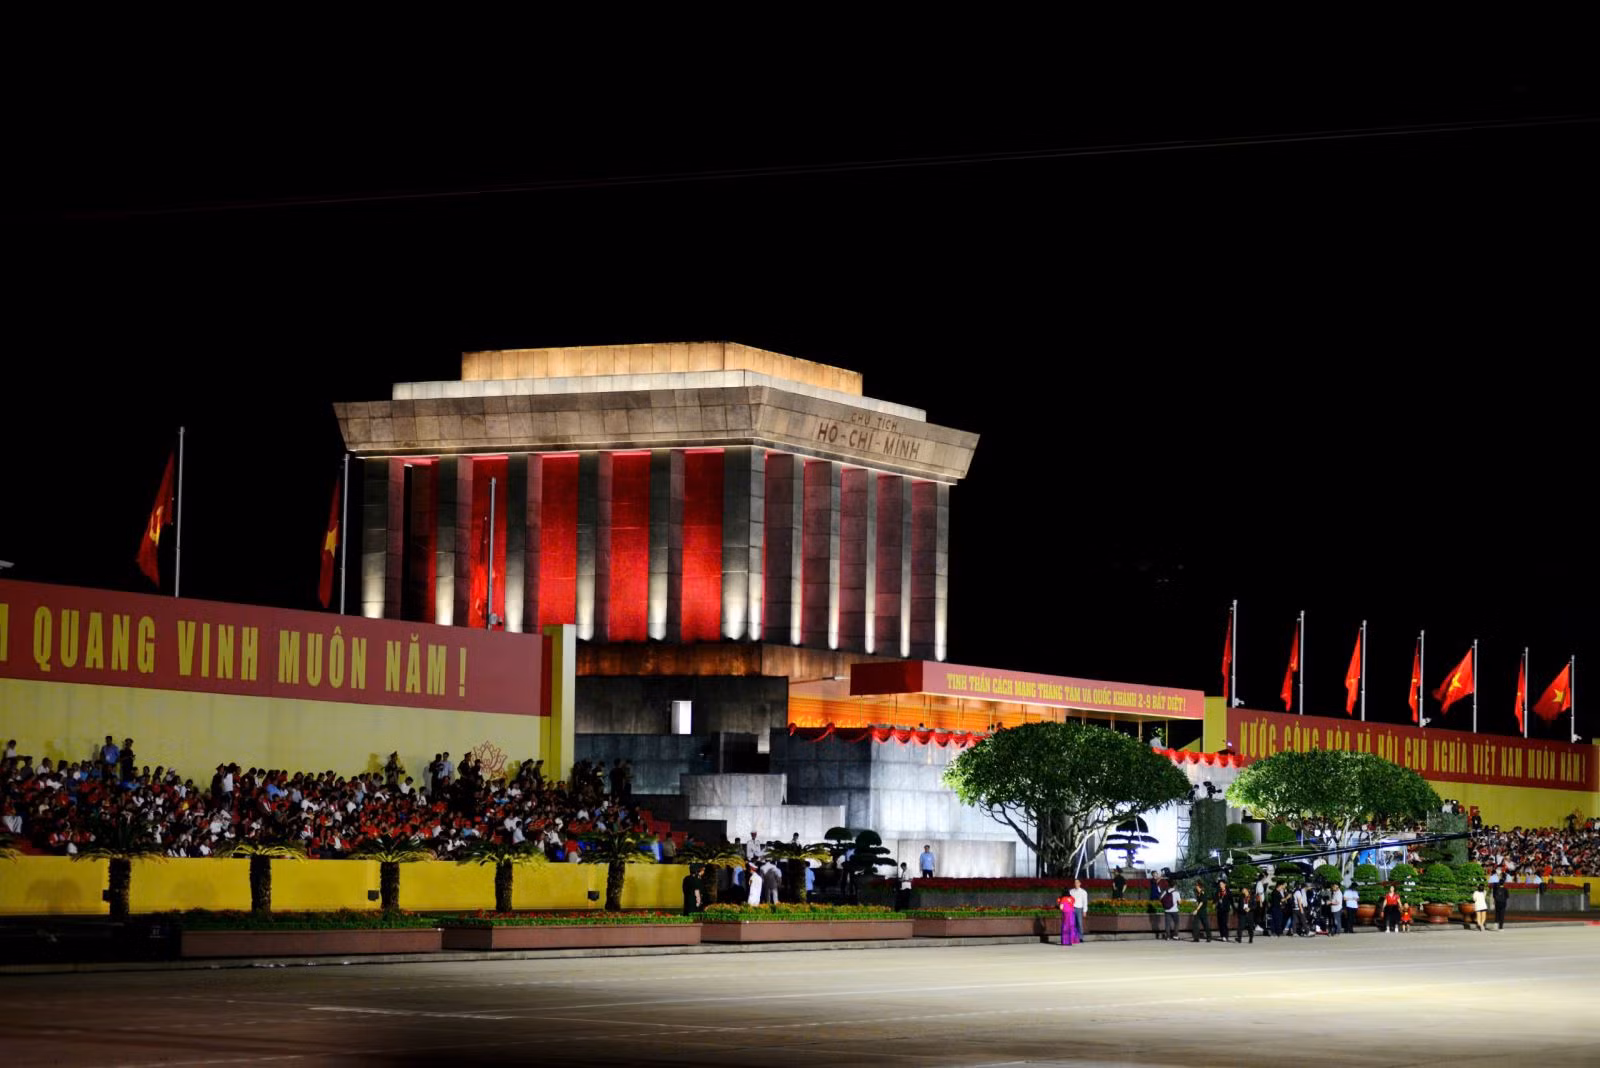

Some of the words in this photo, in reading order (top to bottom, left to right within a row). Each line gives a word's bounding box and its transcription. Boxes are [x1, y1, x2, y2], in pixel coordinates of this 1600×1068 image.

[33, 606, 155, 673] QUANG
[177, 620, 259, 681] VINH
[278, 626, 367, 690] MUÔN
[947, 673, 967, 690] TINH
[992, 676, 1012, 695] CÁCH
[1113, 688, 1136, 707] KHÁNH
[1240, 717, 1276, 758] NƯỚC
[1405, 731, 1427, 771] CHỦ
[1433, 737, 1467, 774] NGHĨA
[1473, 740, 1496, 780] VIỆT
[1501, 746, 1522, 778] NAM
[1528, 746, 1555, 781] MUÔN
